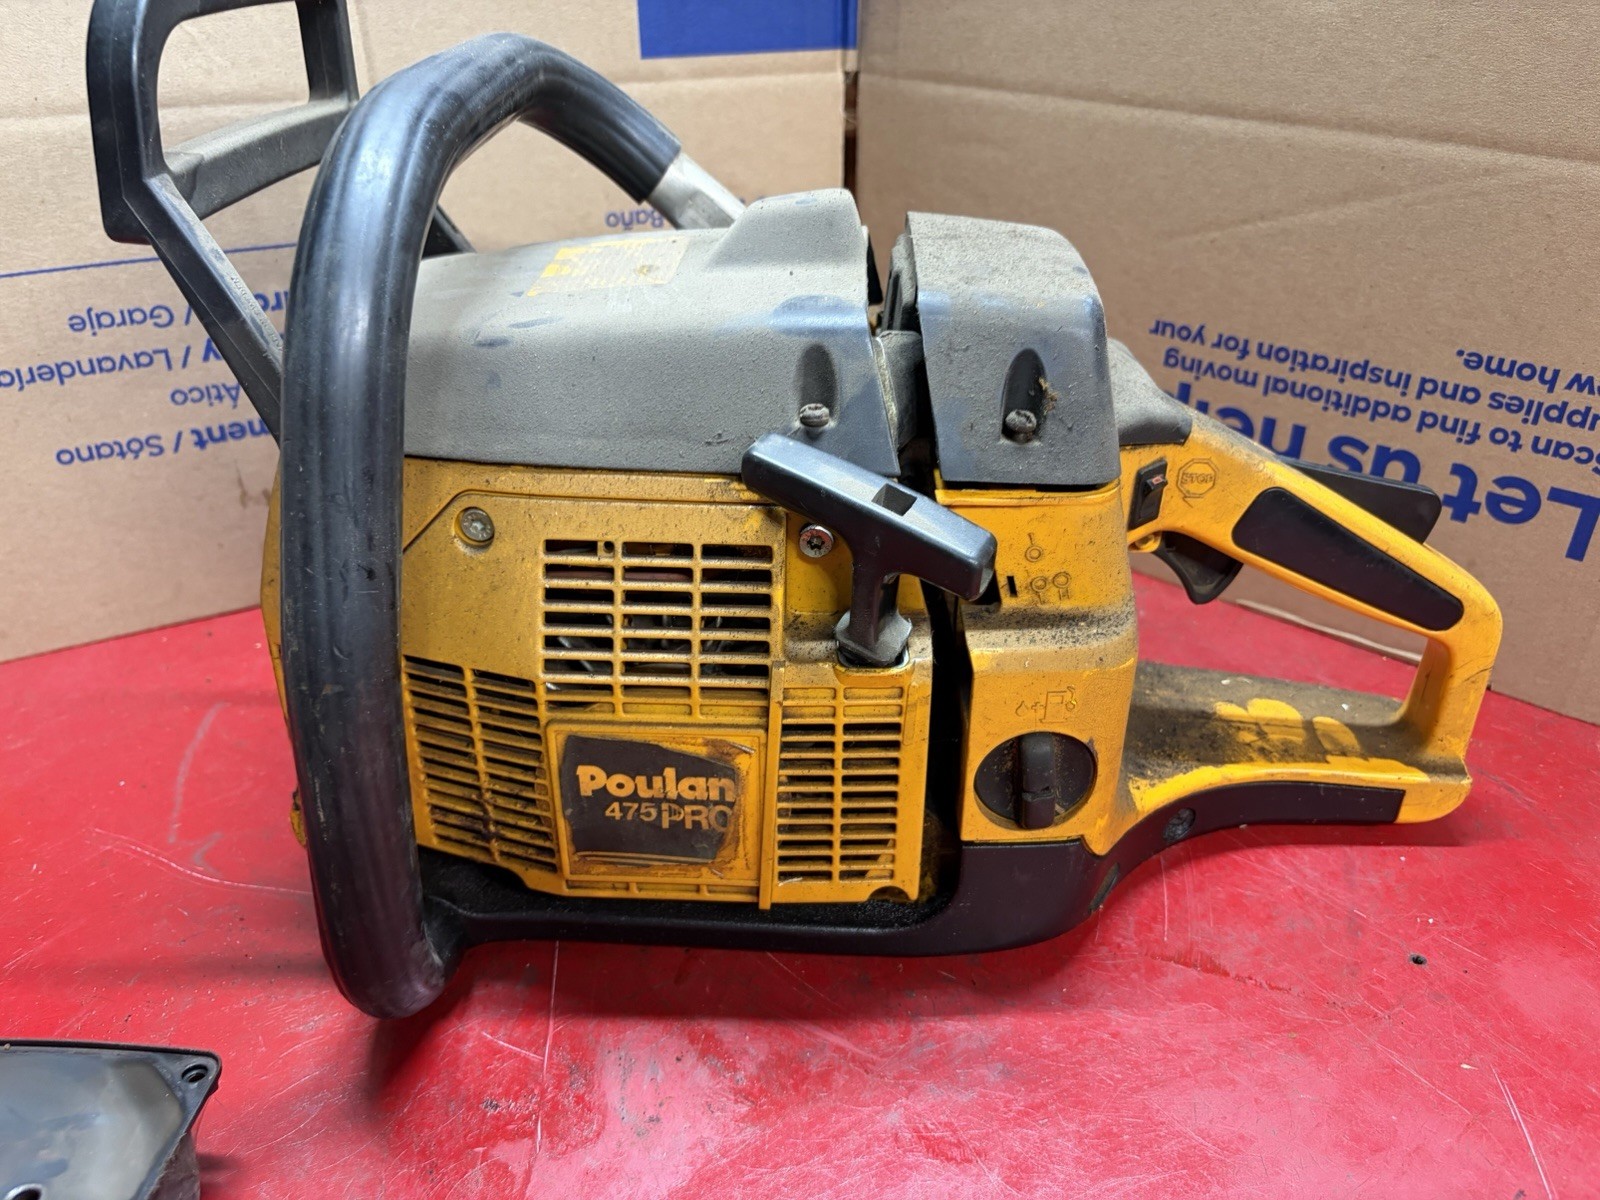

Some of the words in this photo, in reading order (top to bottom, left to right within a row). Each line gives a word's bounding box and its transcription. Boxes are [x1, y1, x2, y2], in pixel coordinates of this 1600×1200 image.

[606, 208, 664, 230] Baño
[67, 305, 174, 337] Garaje
[1149, 320, 1205, 346] your
[1210, 333, 1250, 360] for
[0, 348, 173, 392] Lavandería
[1162, 347, 1258, 389] moving
[1256, 342, 1412, 397] inspiration
[1456, 349, 1561, 394] home.
[170, 383, 240, 410] Ático
[1262, 375, 1412, 422] additional
[1415, 377, 1481, 405] and
[1416, 410, 1481, 445] find
[1488, 427, 1522, 453] to
[56, 435, 165, 466] Sótano
[1327, 435, 1421, 484] us
[1441, 462, 1600, 562] Let
[576, 764, 737, 803] Poulan
[604, 801, 657, 822] 475
[660, 801, 733, 833] PRO
